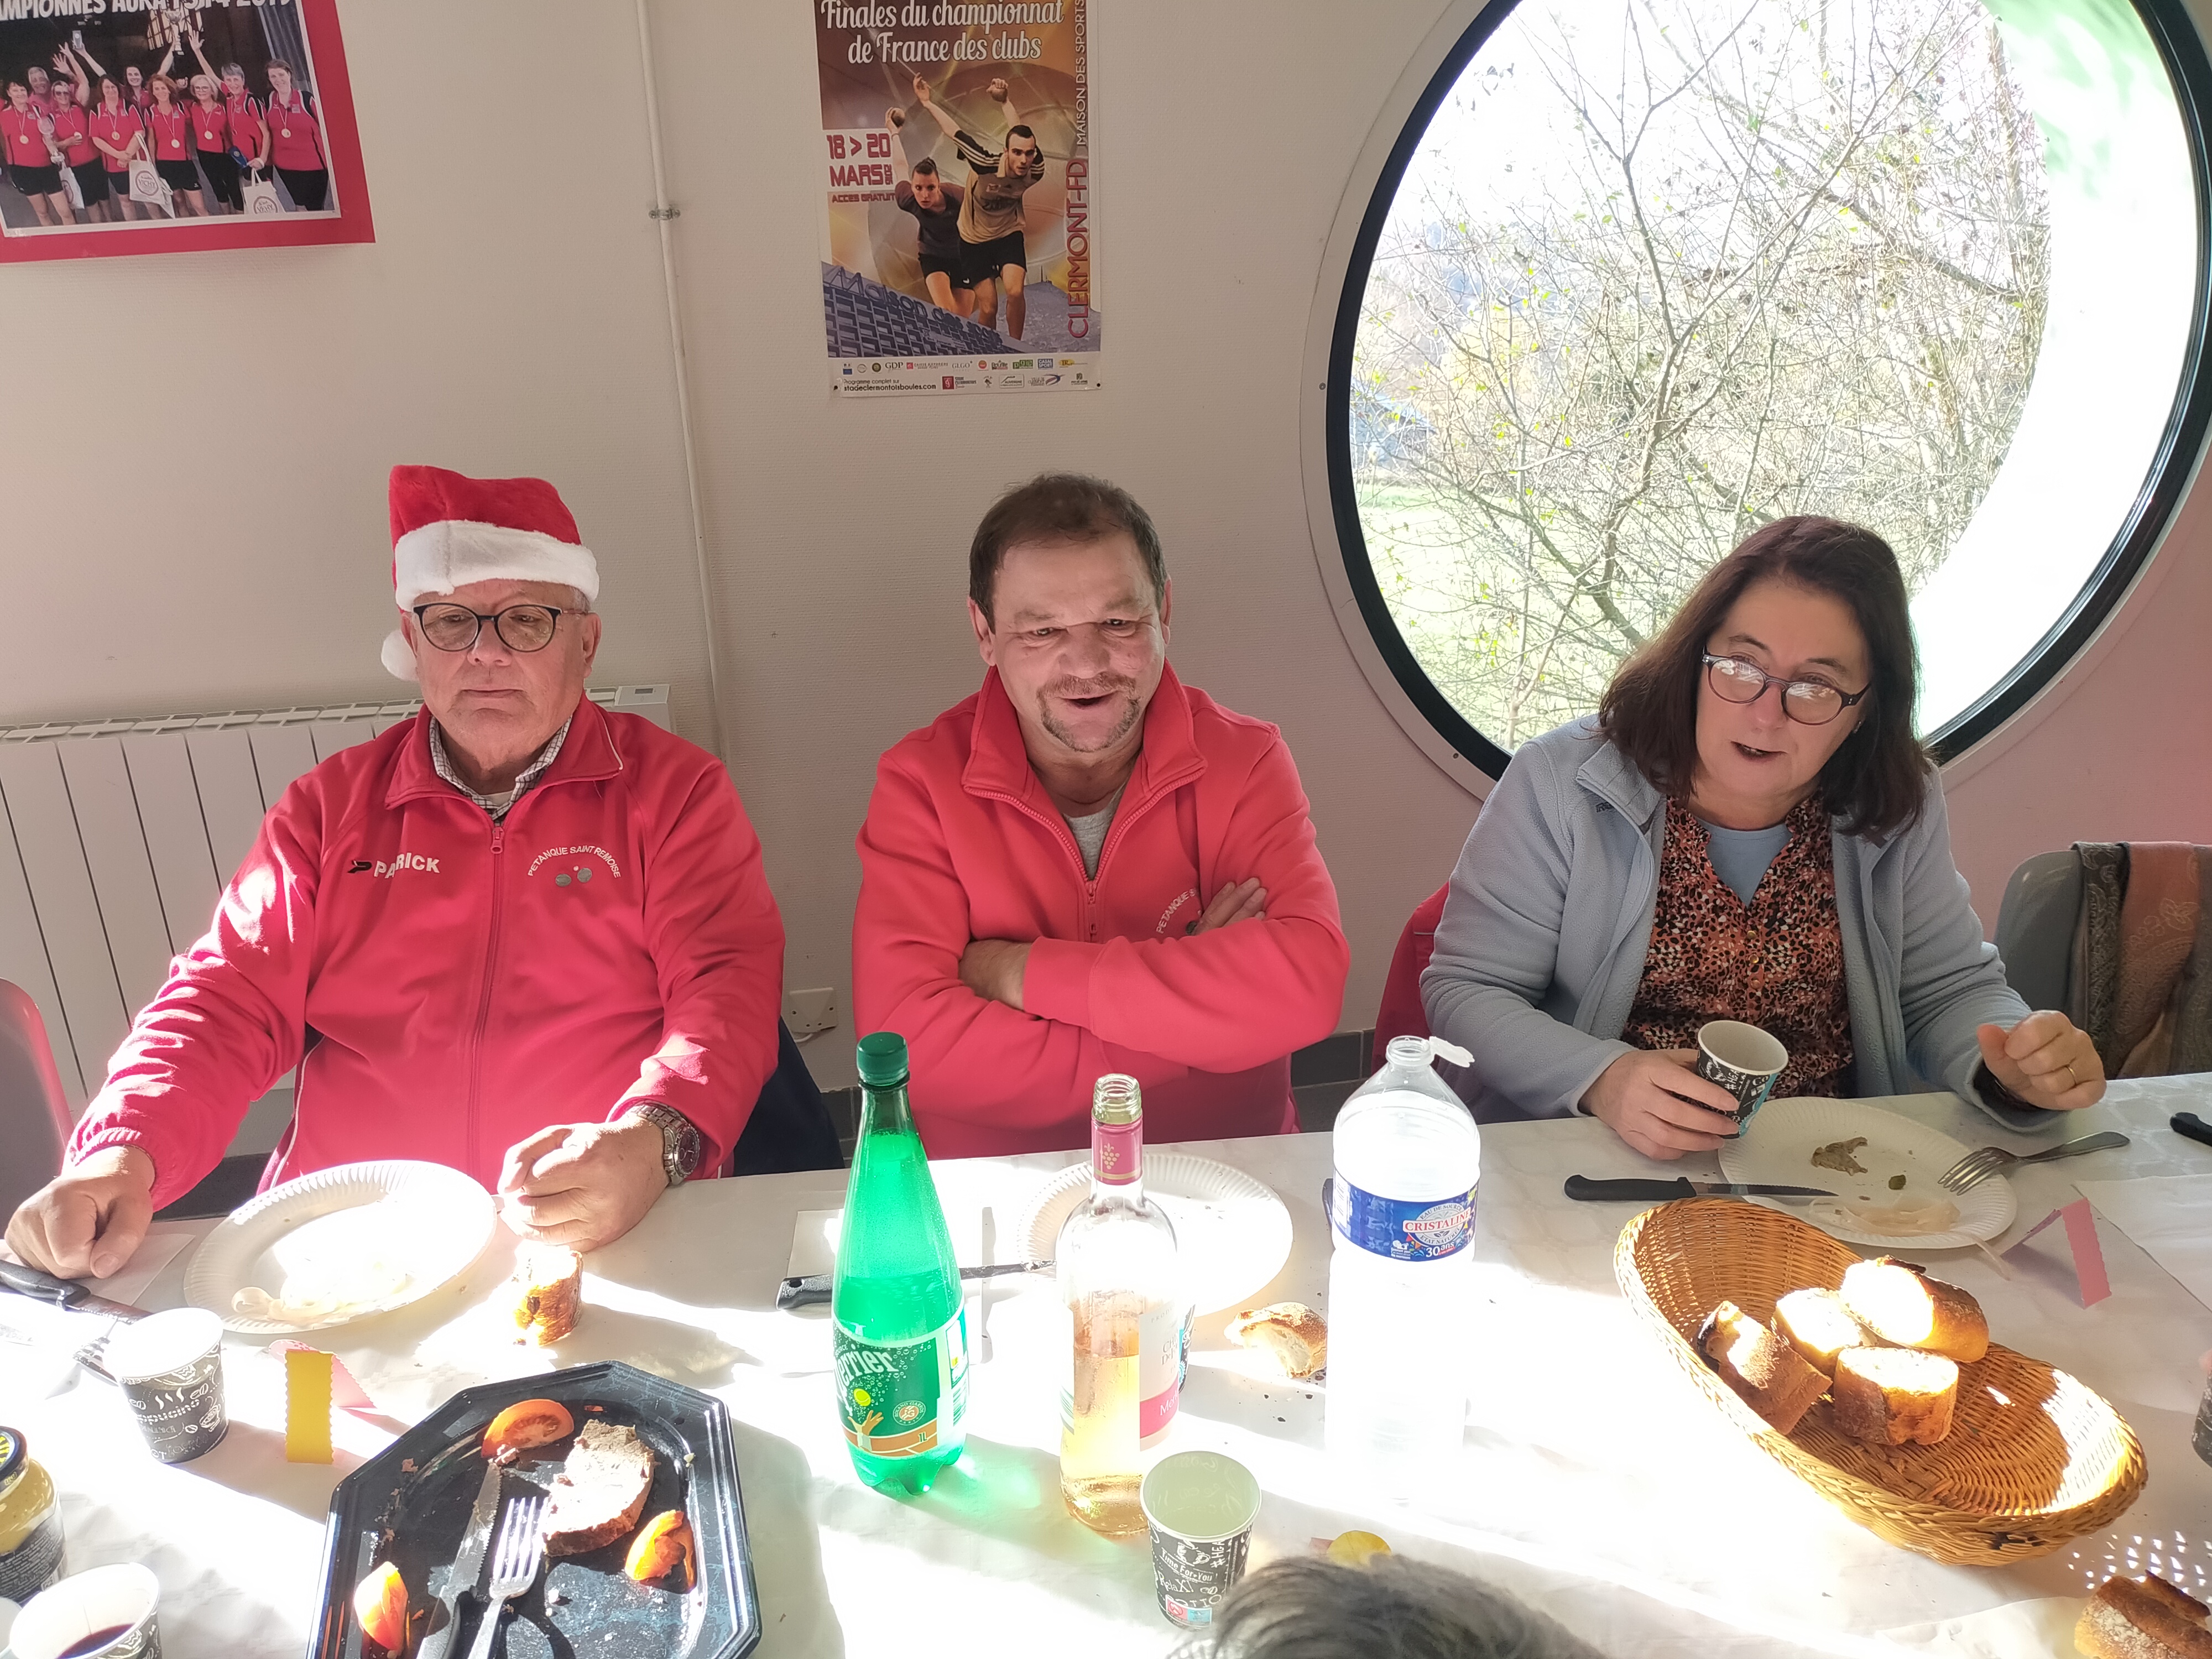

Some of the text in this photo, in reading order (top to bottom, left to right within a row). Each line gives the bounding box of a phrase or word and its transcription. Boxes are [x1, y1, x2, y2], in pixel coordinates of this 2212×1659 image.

[821, 0, 1064, 34] Finales du championnat
[848, 30, 1041, 64] de France des clubs
[1074, 0, 1086, 146] MAISON DES SPORTS
[826, 134, 846, 159] 18
[866, 133, 891, 158] 20
[830, 164, 884, 187] MARS
[832, 192, 895, 203] ACCES GRATUIT
[1066, 158, 1089, 338] CLERMONT-FD
[528, 845, 621, 878] PETANQUE SAINT REMOISE
[1156, 890, 1190, 933] PETANQUE
[1405, 1211, 1471, 1232] CRISTALINE
[1420, 1208, 1433, 1220] EAU
[1443, 1203, 1463, 1212] SOURCE
[1420, 1234, 1435, 1244] ETAT
[1426, 1246, 1441, 1258] 30
[1440, 1241, 1454, 1250] ans
[895, 1401, 924, 1417] ROLAND GARROS
[918, 1432, 928, 1443] 1L
[1162, 1551, 1178, 1570] Time
[1180, 1565, 1194, 1577] For
